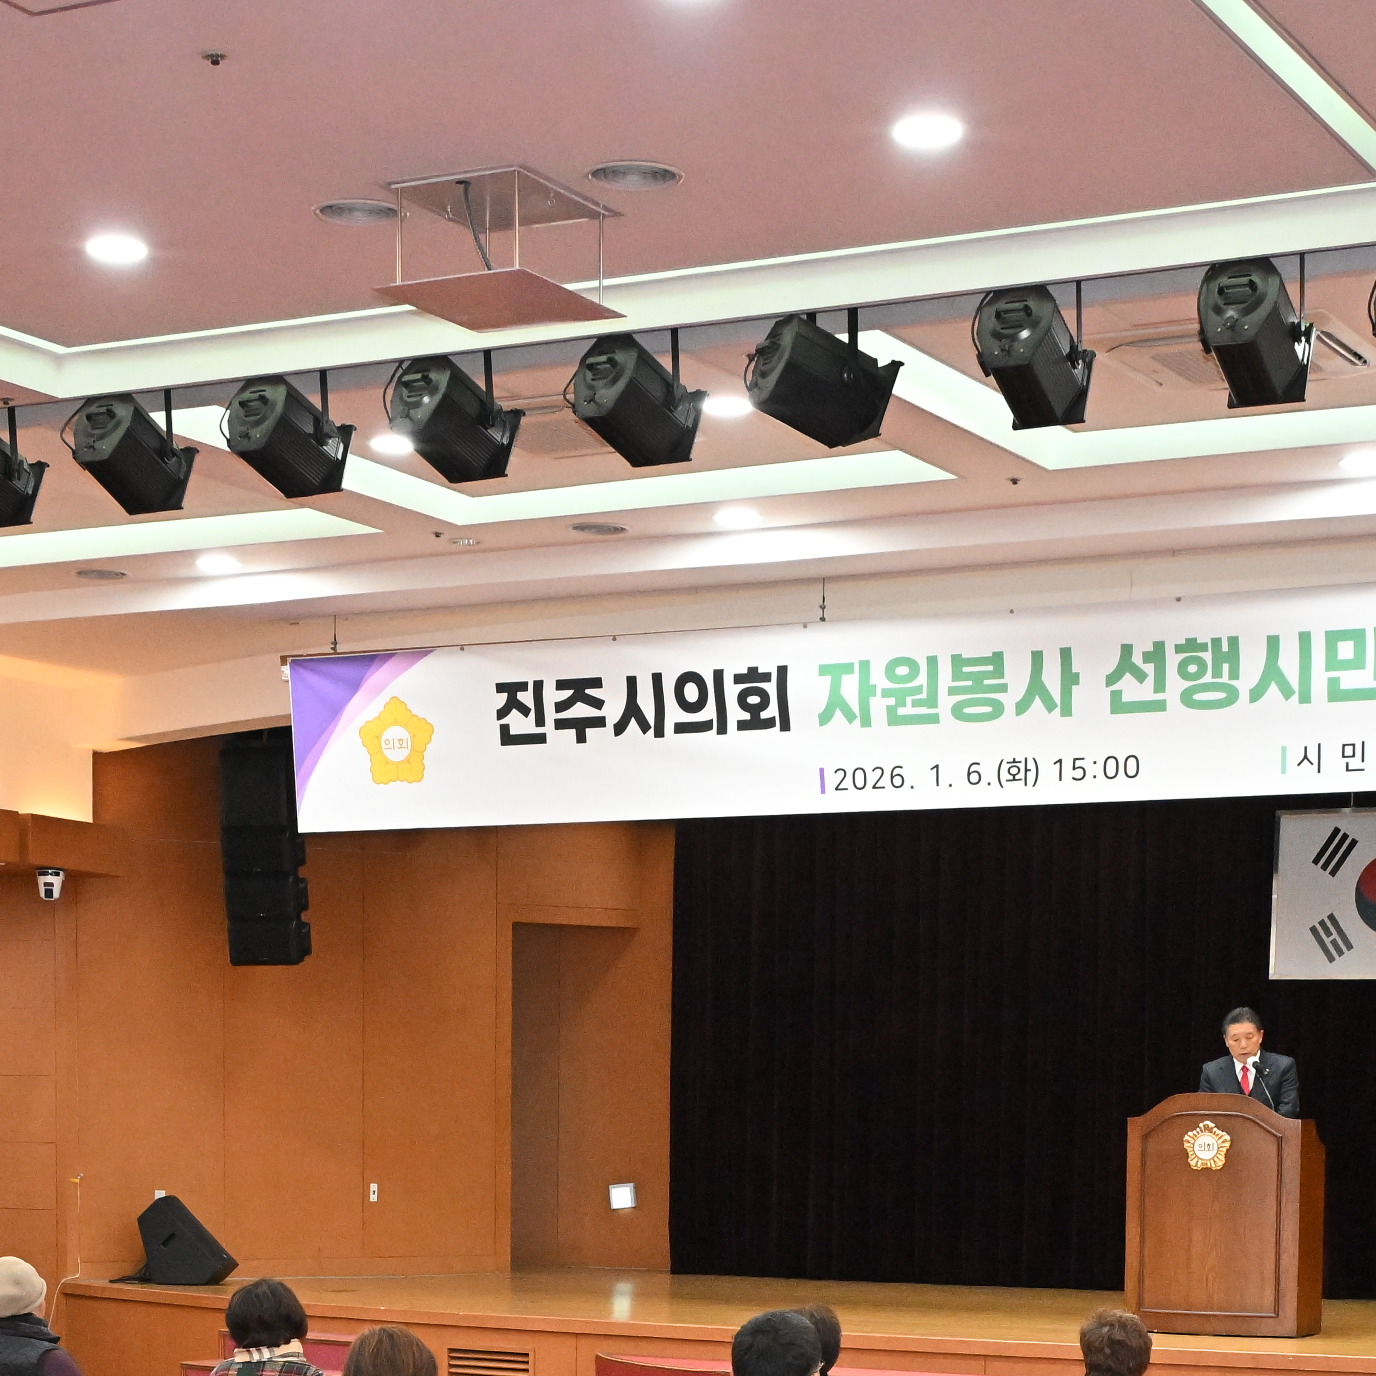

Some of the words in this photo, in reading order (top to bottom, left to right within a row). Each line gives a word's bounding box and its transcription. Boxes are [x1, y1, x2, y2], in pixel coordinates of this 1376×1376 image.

[495, 664, 791, 747] 진주시의회
[817, 646, 1081, 729] 자원봉사
[383, 737, 409, 751] 의회
[834, 765, 915, 791] 2026.
[929, 762, 955, 788] 1.
[966, 757, 1039, 789] 6.(화)
[1053, 754, 1140, 782] 15:00
[1197, 1142, 1214, 1152] 의회
